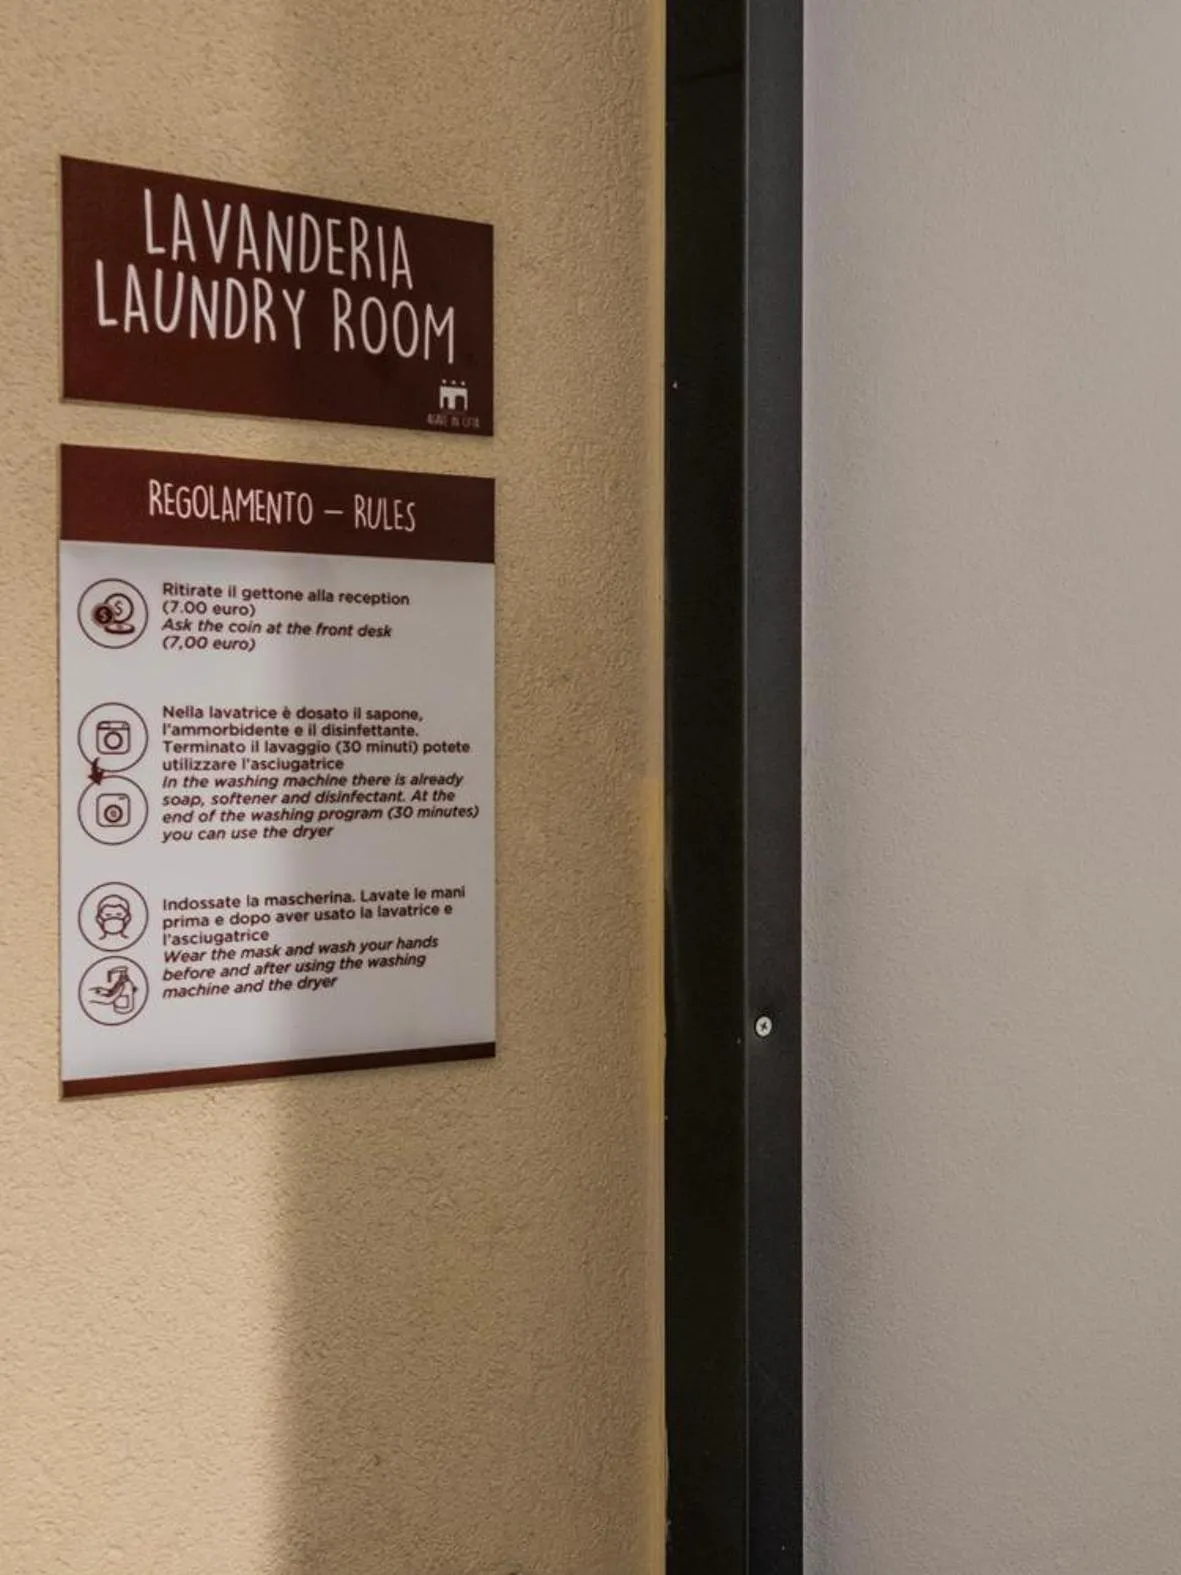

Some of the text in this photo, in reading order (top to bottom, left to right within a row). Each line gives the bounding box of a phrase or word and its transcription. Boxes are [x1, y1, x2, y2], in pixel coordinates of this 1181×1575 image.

[144, 188, 413, 290] LAVANDERIA
[96, 257, 454, 364] LAUNDRY ROOM
[149, 479, 313, 525] REGOLAMENTO
[354, 494, 415, 532] RULES
[163, 582, 410, 606] Ritirate il gettone alla reception
[213, 604, 256, 617] euro)
[161, 618, 392, 638] Ask the coin at the front desk
[212, 638, 256, 652] euro)
[163, 705, 423, 722] Nella lavatrice è dosato il sapone,
[162, 722, 419, 739] l'ammorbidente e il disinfettante.
[162, 739, 471, 758] Terminato il lavaggio (30 minuti) potete
[162, 755, 344, 774] utilizzare l'asciugatrice
[162, 772, 464, 790] In the washing machine there is already
[162, 789, 455, 808] soap, softener and disinfectant. At the
[162, 805, 479, 824] end of the washing program (30 minutes)
[162, 825, 334, 844] you can use the dryer
[163, 885, 465, 912] Indossate la mascherina. Lavate le mani
[162, 903, 453, 931] prima e dopo aver usato la lavatrice e
[163, 930, 269, 946] l'asciugatrice
[164, 935, 439, 963] Wear the mask and wash your hands
[162, 953, 426, 981] before and after using the washing
[162, 976, 338, 998] machine and the dryer
